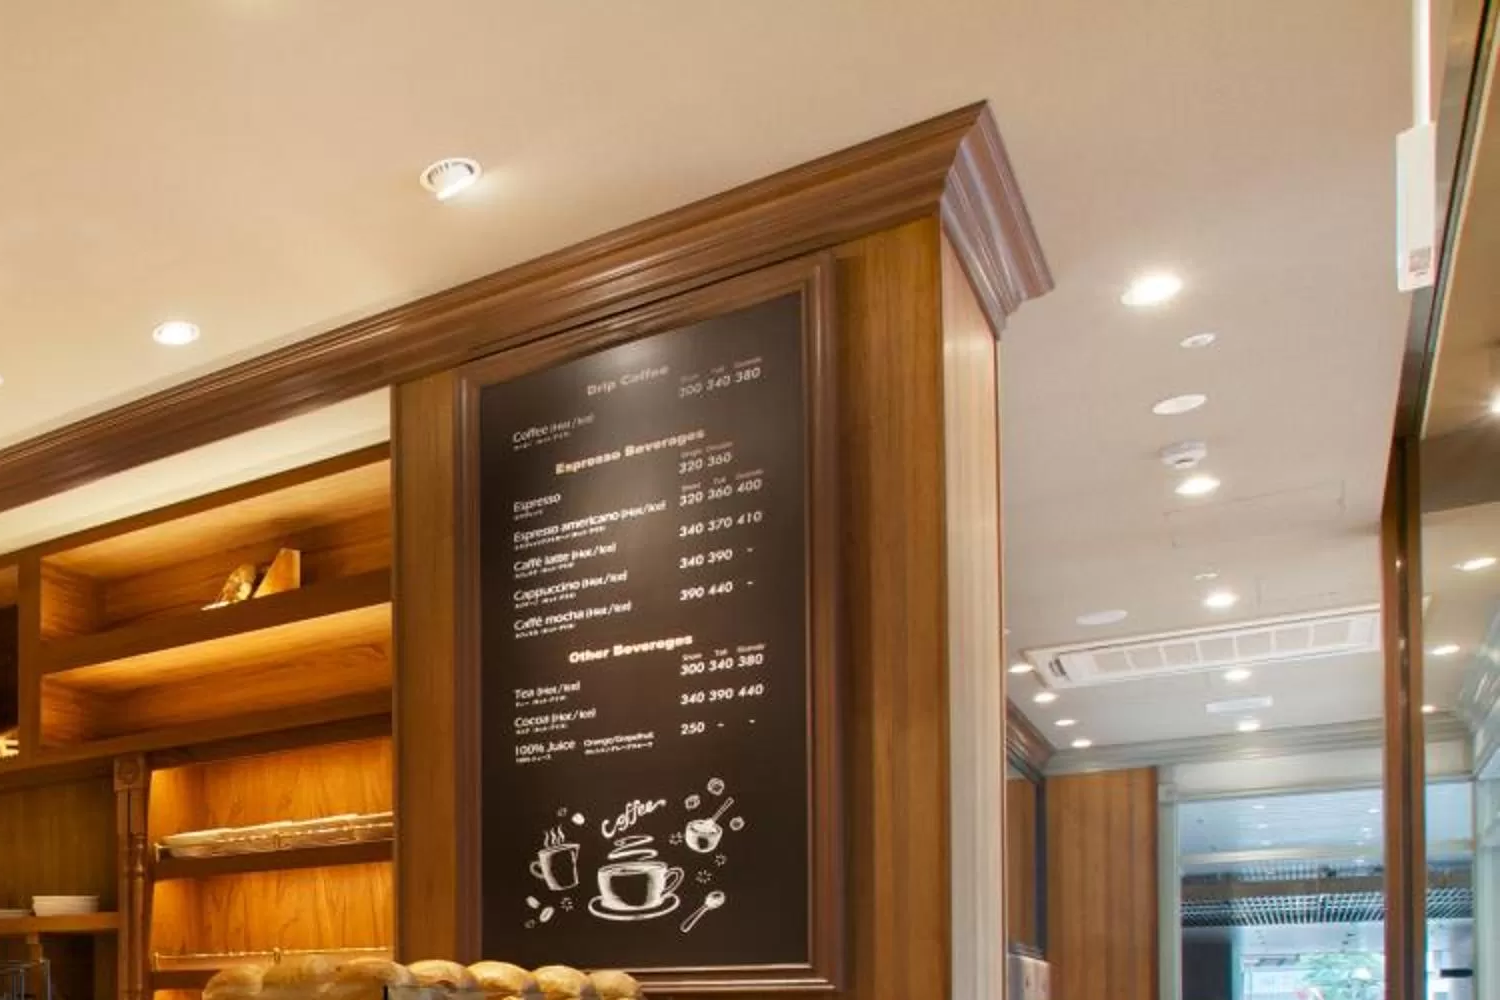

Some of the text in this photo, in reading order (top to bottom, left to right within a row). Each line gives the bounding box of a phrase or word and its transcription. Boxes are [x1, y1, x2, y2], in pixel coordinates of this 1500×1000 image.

[735, 367, 761, 383] 380
[555, 451, 622, 475] Espresso
[624, 429, 705, 457] Beverages
[679, 458, 703, 475] 320
[707, 451, 733, 468] 360
[513, 493, 562, 513] Espresso
[679, 491, 704, 507] 320
[707, 485, 733, 501] 360
[737, 479, 763, 494] 400
[679, 511, 763, 537] 340 370 410
[679, 548, 733, 569] 340 390
[513, 580, 581, 603] Cappuccino
[680, 581, 733, 602] 390 440
[545, 608, 585, 625] mocha
[568, 649, 611, 664] Other
[613, 635, 693, 657] Beverages
[680, 661, 705, 676] 300
[708, 657, 734, 672] 340
[737, 653, 764, 668] 380
[514, 688, 535, 700] Tea
[680, 683, 764, 705] 340 390 440
[513, 714, 549, 728] Cocoa
[680, 721, 705, 736] 250
[515, 743, 545, 757] 100%
[546, 740, 576, 753] Juice
[601, 799, 668, 838] Coffee
